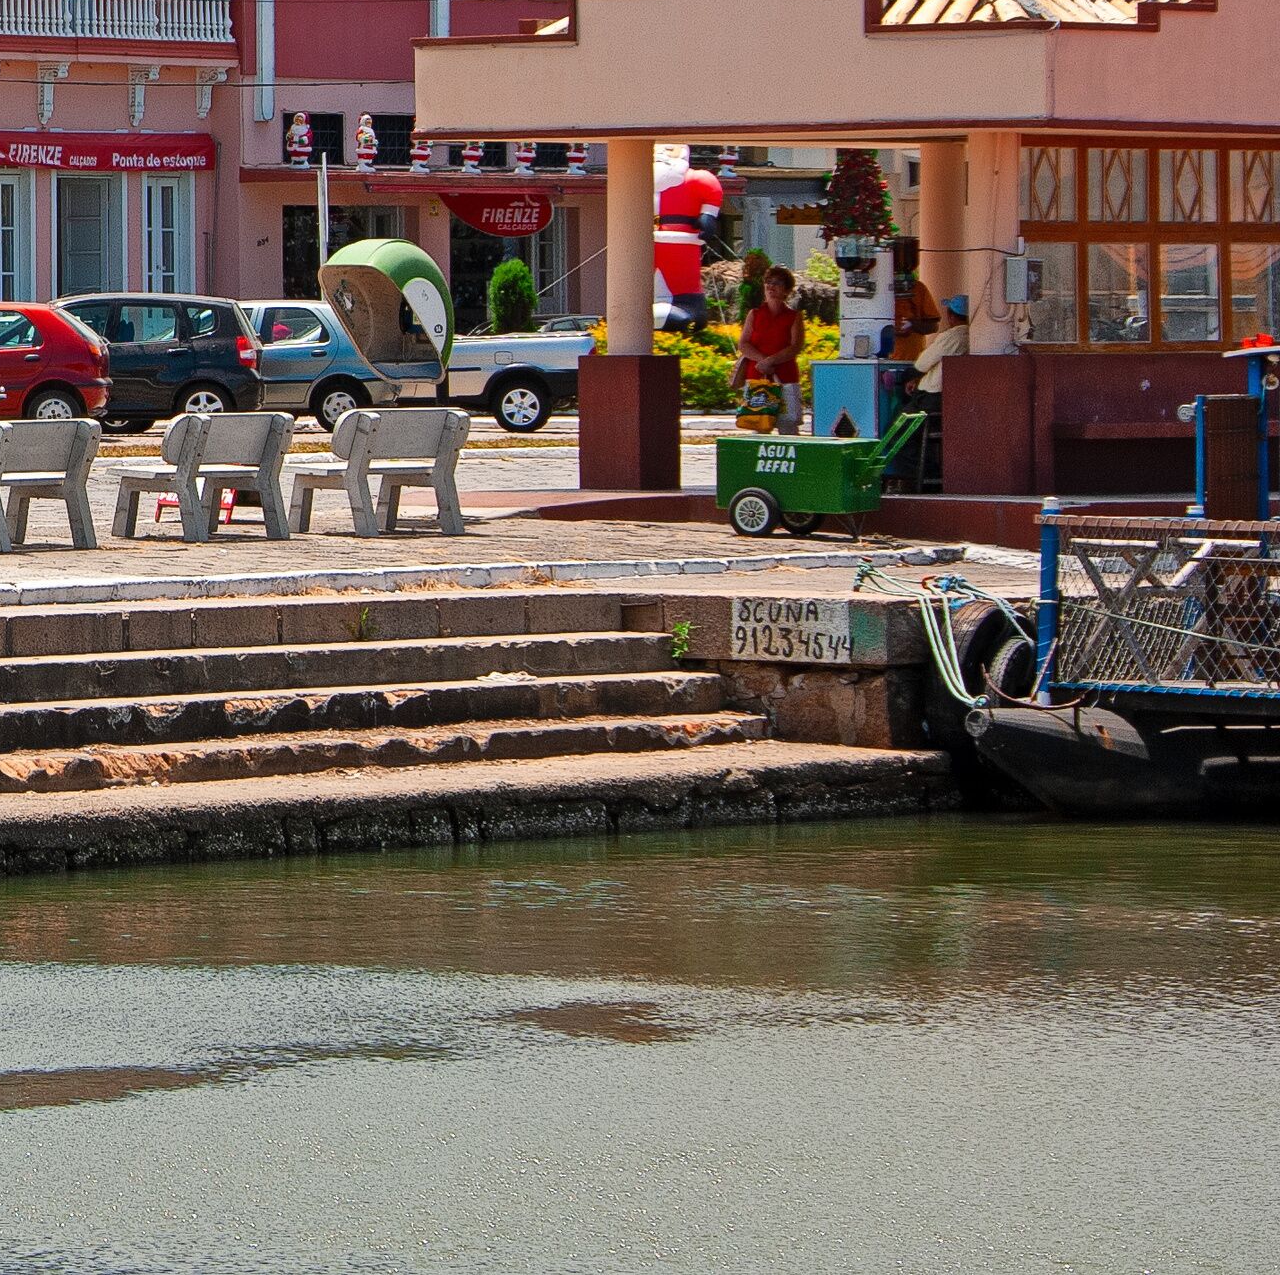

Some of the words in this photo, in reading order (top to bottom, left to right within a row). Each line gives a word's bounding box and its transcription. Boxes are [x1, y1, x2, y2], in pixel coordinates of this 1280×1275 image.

[8, 143, 63, 165] FIRENZE
[112, 152, 145, 167] Ponta
[146, 152, 161, 167] de
[162, 154, 207, 169] estoque
[481, 208, 540, 223] FIRENZE
[757, 442, 796, 459] ÁGUA
[755, 460, 795, 473] REFRI
[735, 625, 855, 660] 91234544
